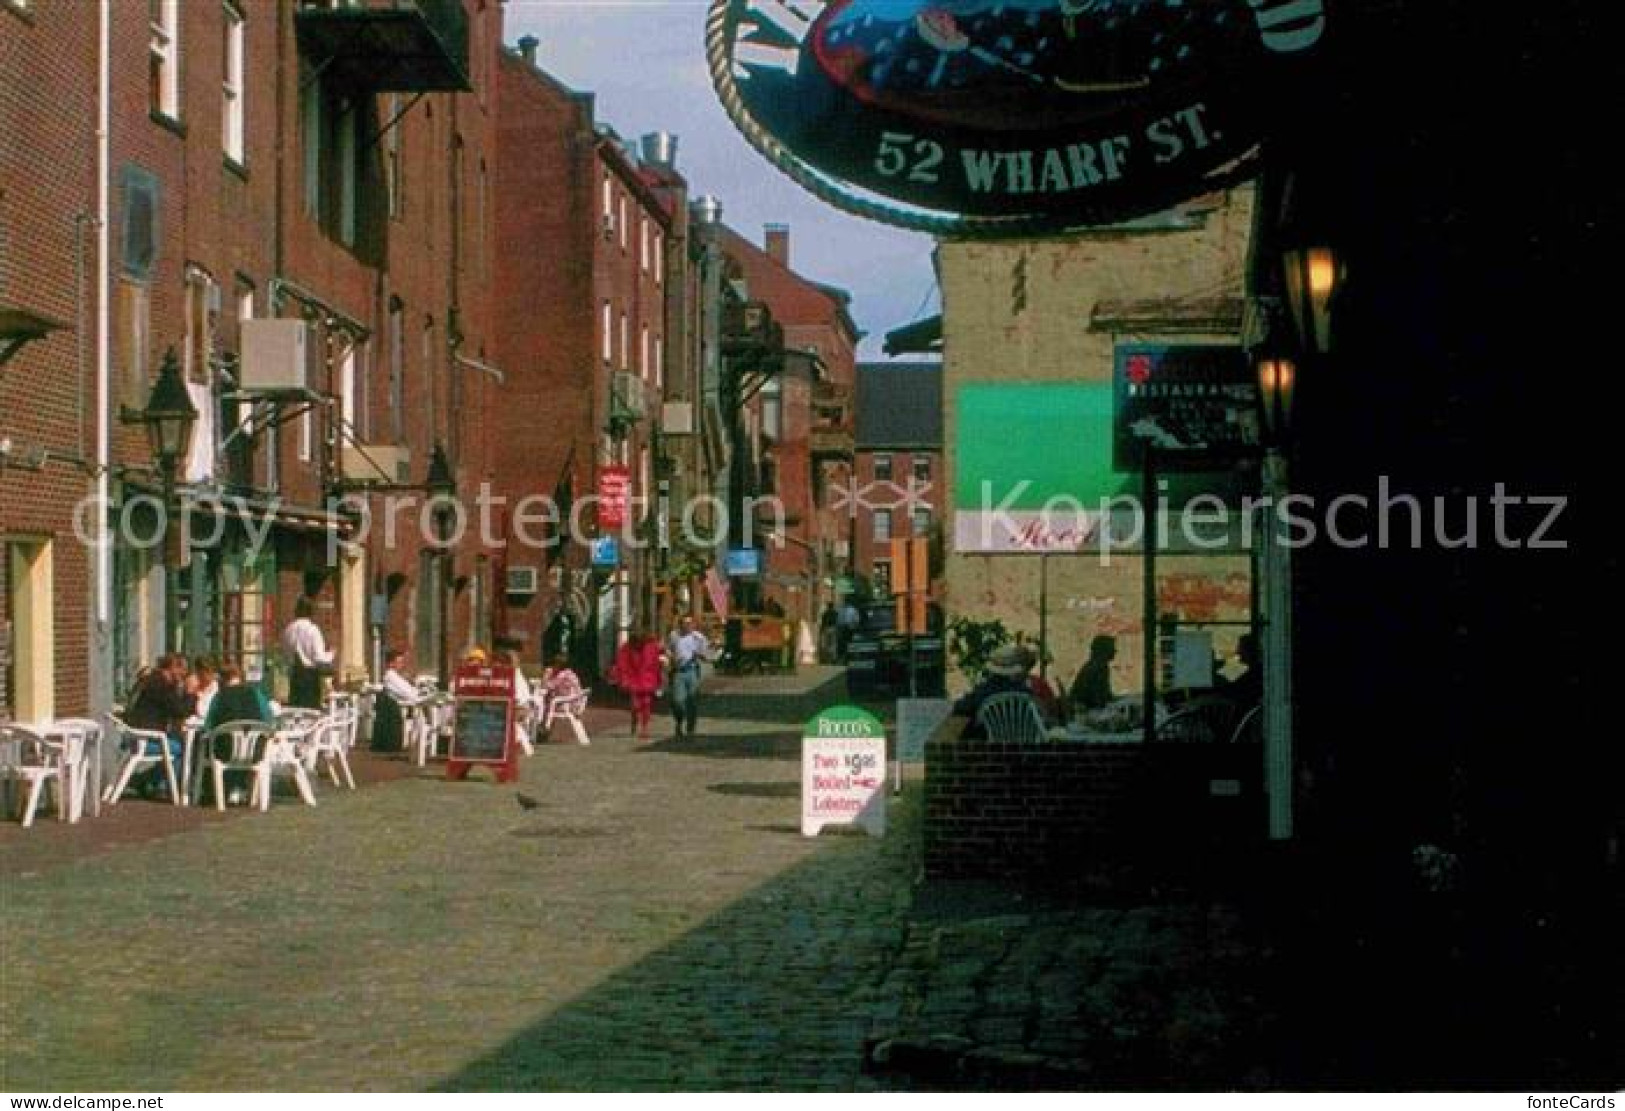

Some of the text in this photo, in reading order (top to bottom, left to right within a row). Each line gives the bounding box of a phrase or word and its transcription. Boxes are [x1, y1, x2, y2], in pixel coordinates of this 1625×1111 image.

[875, 102, 1223, 193] 52 WHARF ST.
[813, 754, 838, 768] Two
[812, 774, 850, 789] Boiled
[812, 796, 862, 812] Lobsters
